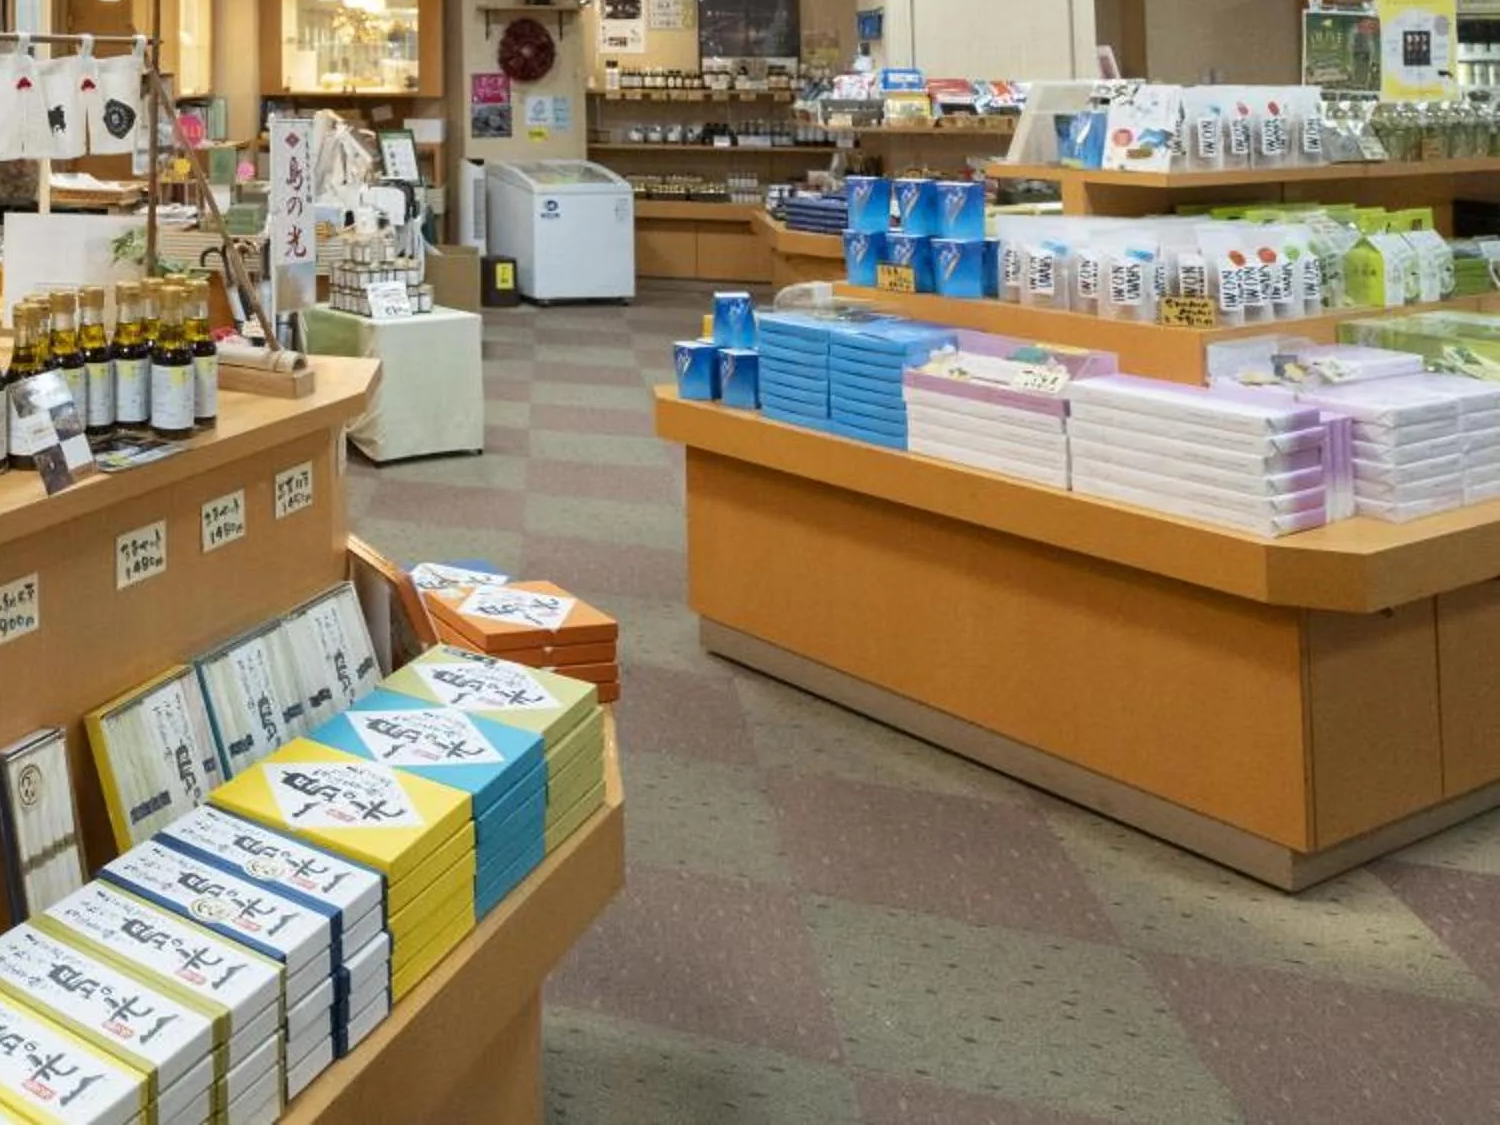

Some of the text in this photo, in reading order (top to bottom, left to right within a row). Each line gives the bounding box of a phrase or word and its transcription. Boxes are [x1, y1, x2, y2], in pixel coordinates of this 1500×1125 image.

[285, 156, 307, 258] 島の光
[365, 716, 485, 759] 島の光
[280, 770, 408, 821] 島の光
[232, 832, 330, 877] 島の光
[177, 869, 277, 919] 島の光
[120, 916, 224, 971] 島の光
[48, 962, 153, 1022] 島の光
